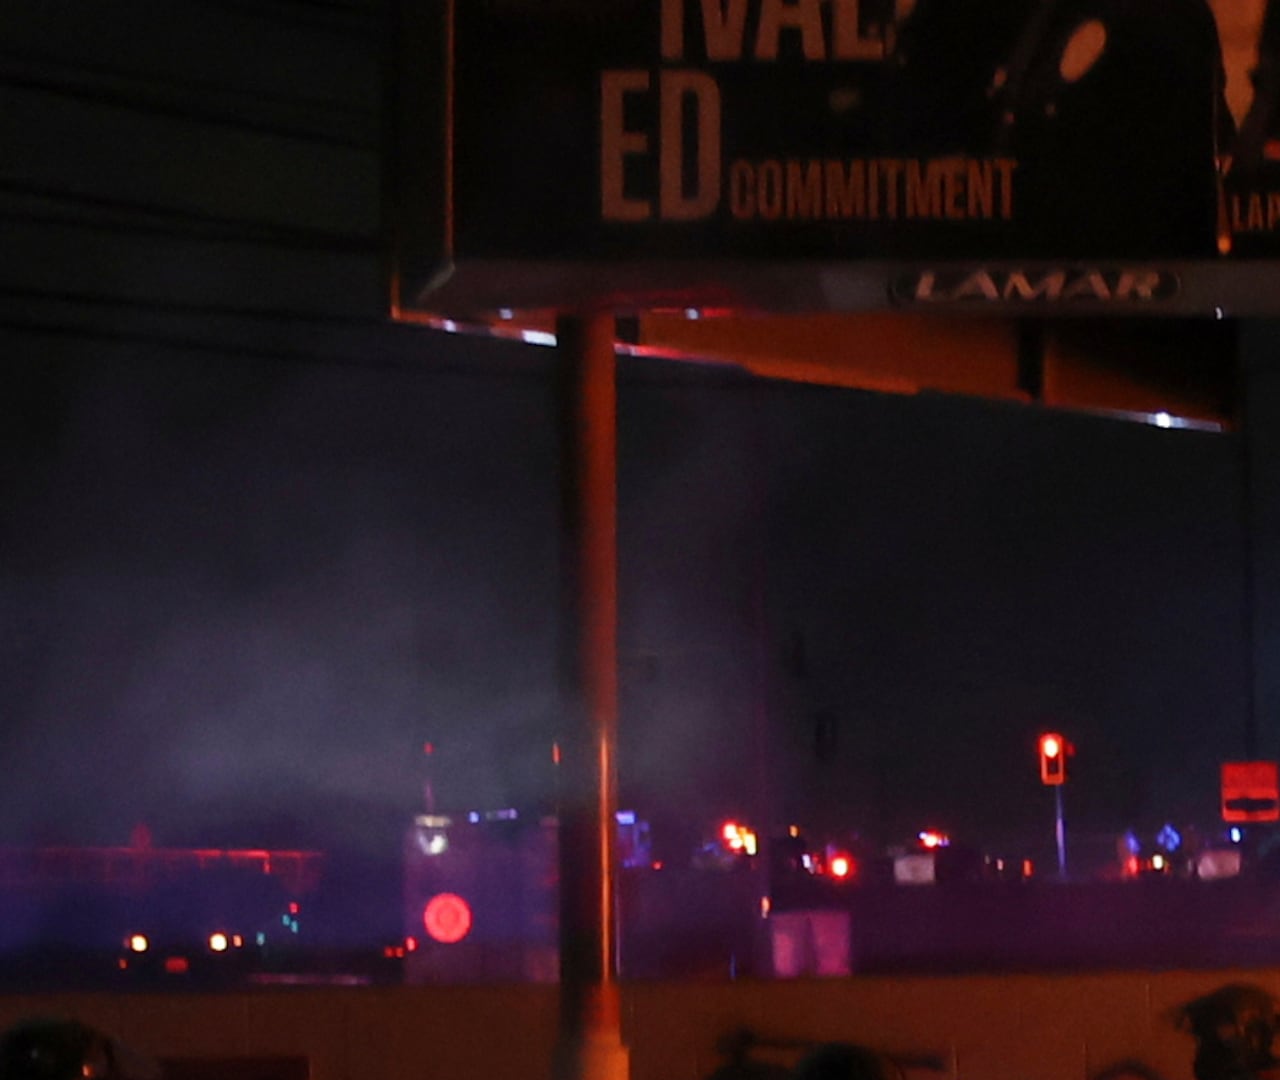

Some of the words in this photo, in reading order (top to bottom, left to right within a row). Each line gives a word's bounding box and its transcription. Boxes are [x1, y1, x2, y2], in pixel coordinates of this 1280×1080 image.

[600, 68, 723, 222] ED
[728, 156, 1019, 221] COMMITMENT
[914, 268, 1161, 302] LAMAR
